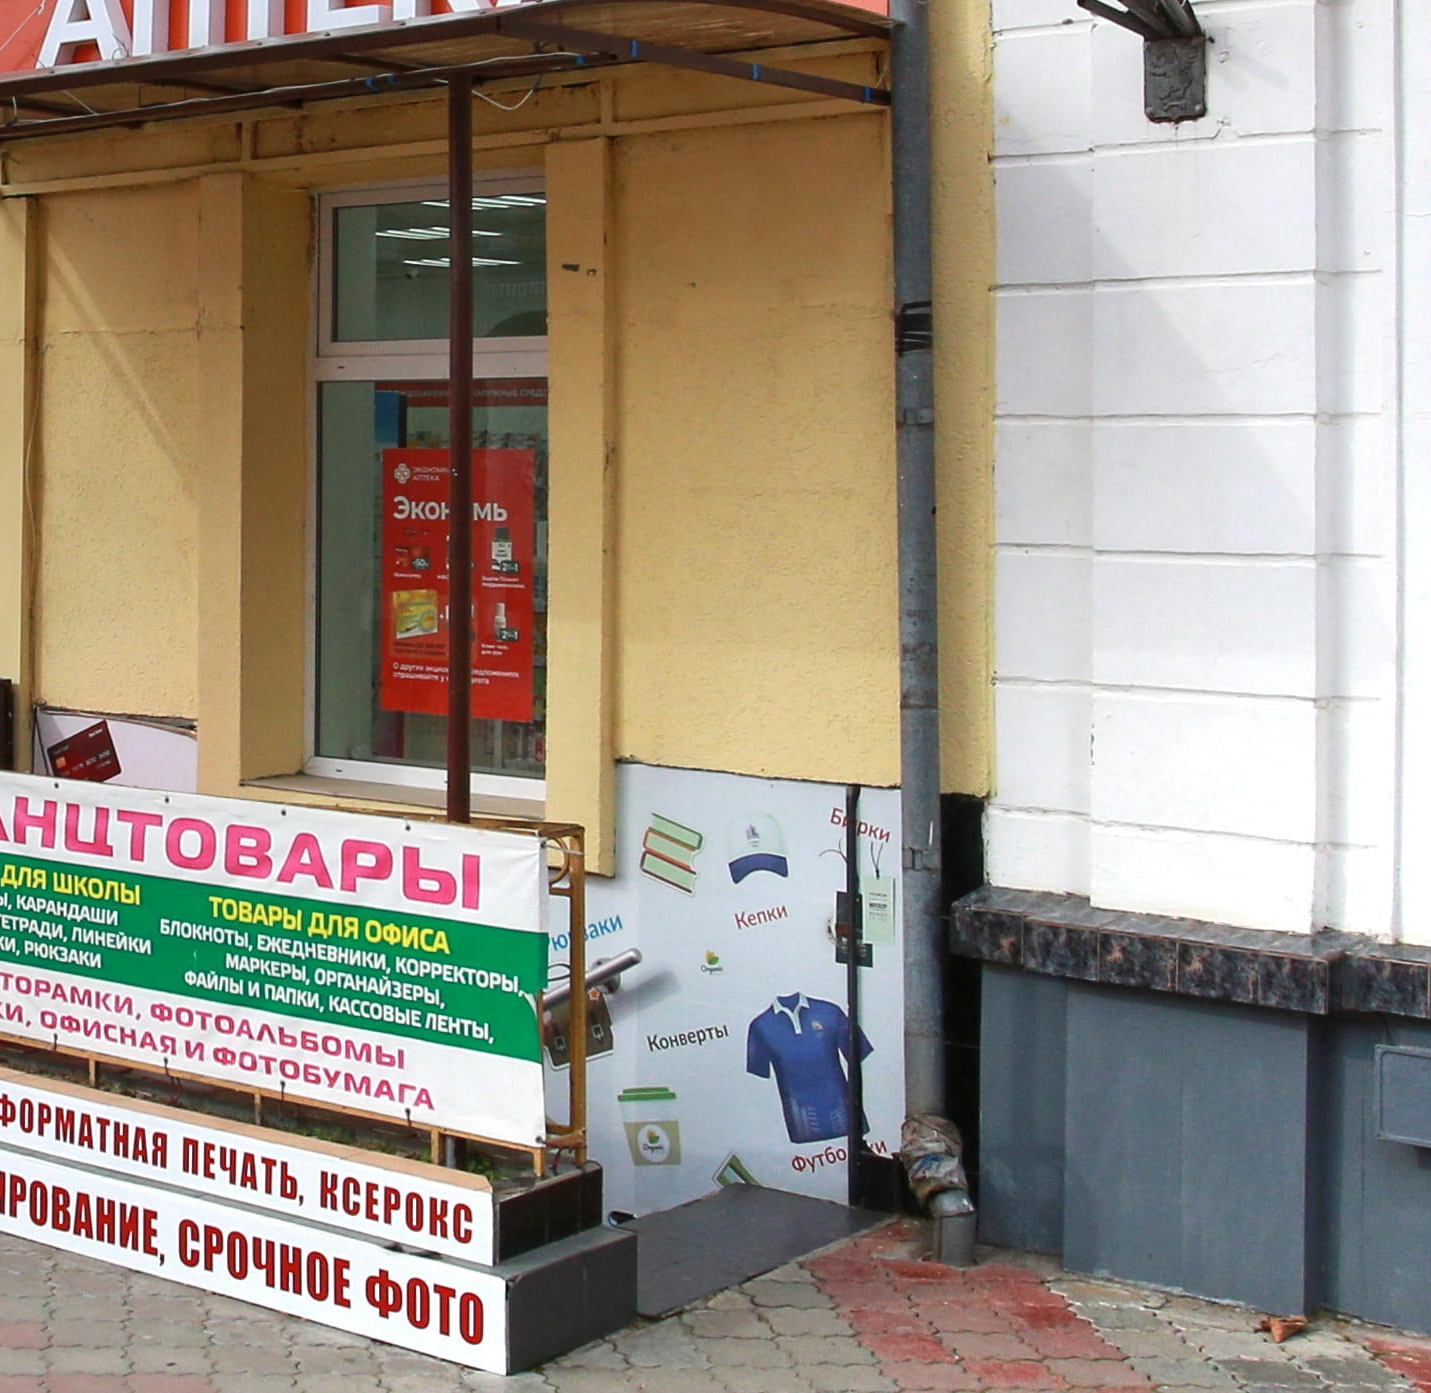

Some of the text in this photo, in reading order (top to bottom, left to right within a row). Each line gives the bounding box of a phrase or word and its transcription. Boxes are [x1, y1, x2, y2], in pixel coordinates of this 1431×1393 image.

[393, 495, 508, 521] Эконмь
[0, 863, 47, 890] ДЛЯ
[53, 872, 141, 905] ШКОЛЫ
[16, 894, 118, 927] КАРАНДАШИ
[209, 896, 451, 955] ТОВАРЫ ДЛЯ ОФИСА
[734, 905, 789, 930] Кепки
[71, 924, 152, 955] ЛИНЕЙКИ
[551, 914, 624, 951] юаки
[24, 940, 102, 968] РЮКЗАКИ
[160, 918, 526, 997] БЛОКНОТЫ, ЕЖЕДНЕВНИКИ, КОРРЕКТОРЫ,
[225, 952, 446, 1009] МАРКЕРЫ, ОРГАНАЙЗЕРЫ,
[184, 969, 495, 1044] ФАЙЛЫ И ПАПКИ, КАССОВЫЕ ЛЕНТЫ,
[151, 1002, 405, 1070] ФОТОАЛЬБОМЫ
[646, 1023, 730, 1053] Конверты
[40, 1010, 177, 1057] ОФИСНАЯ
[184, 1040, 206, 1062] И
[212, 1045, 435, 1111] ФОТОБУМАГА
[792, 1140, 888, 1173] Футбои
[182, 1137, 305, 1206] ПЕЧАТЬ,
[319, 1169, 474, 1245] КСЕРОКС
[178, 1217, 351, 1309] СРОЧНОЕ
[365, 1268, 485, 1346] ФОТО
